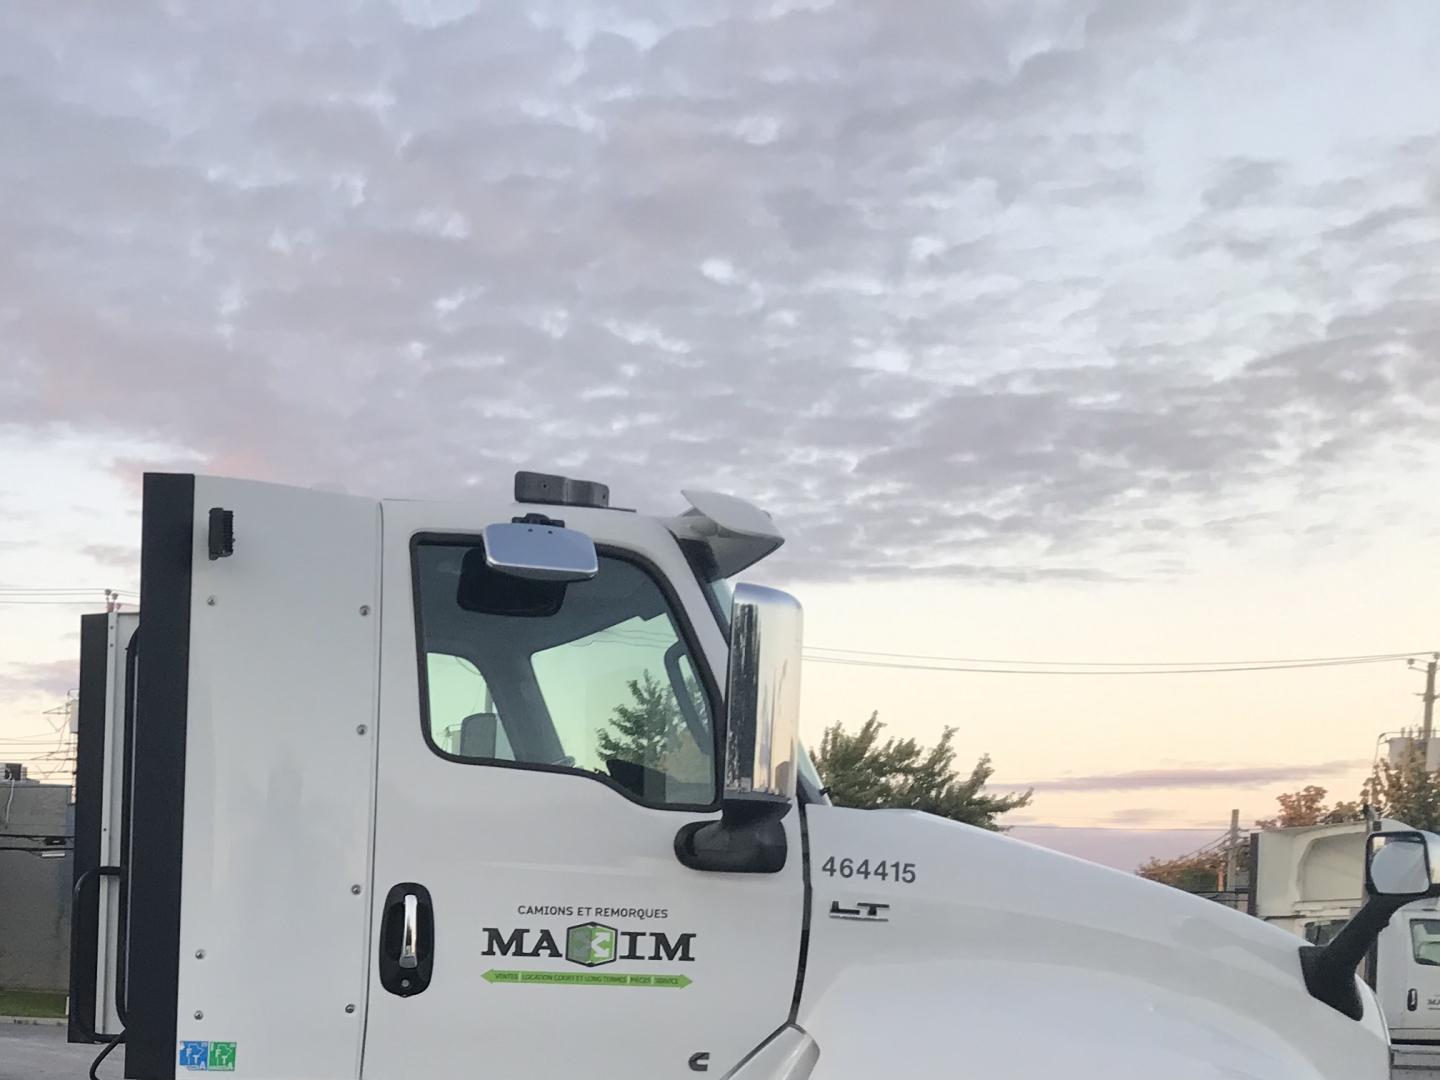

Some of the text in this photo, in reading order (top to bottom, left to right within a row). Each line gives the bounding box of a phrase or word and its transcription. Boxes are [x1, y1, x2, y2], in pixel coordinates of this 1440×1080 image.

[822, 856, 916, 884] 464415
[517, 905, 669, 920] CAMIONS ET REMORQUES
